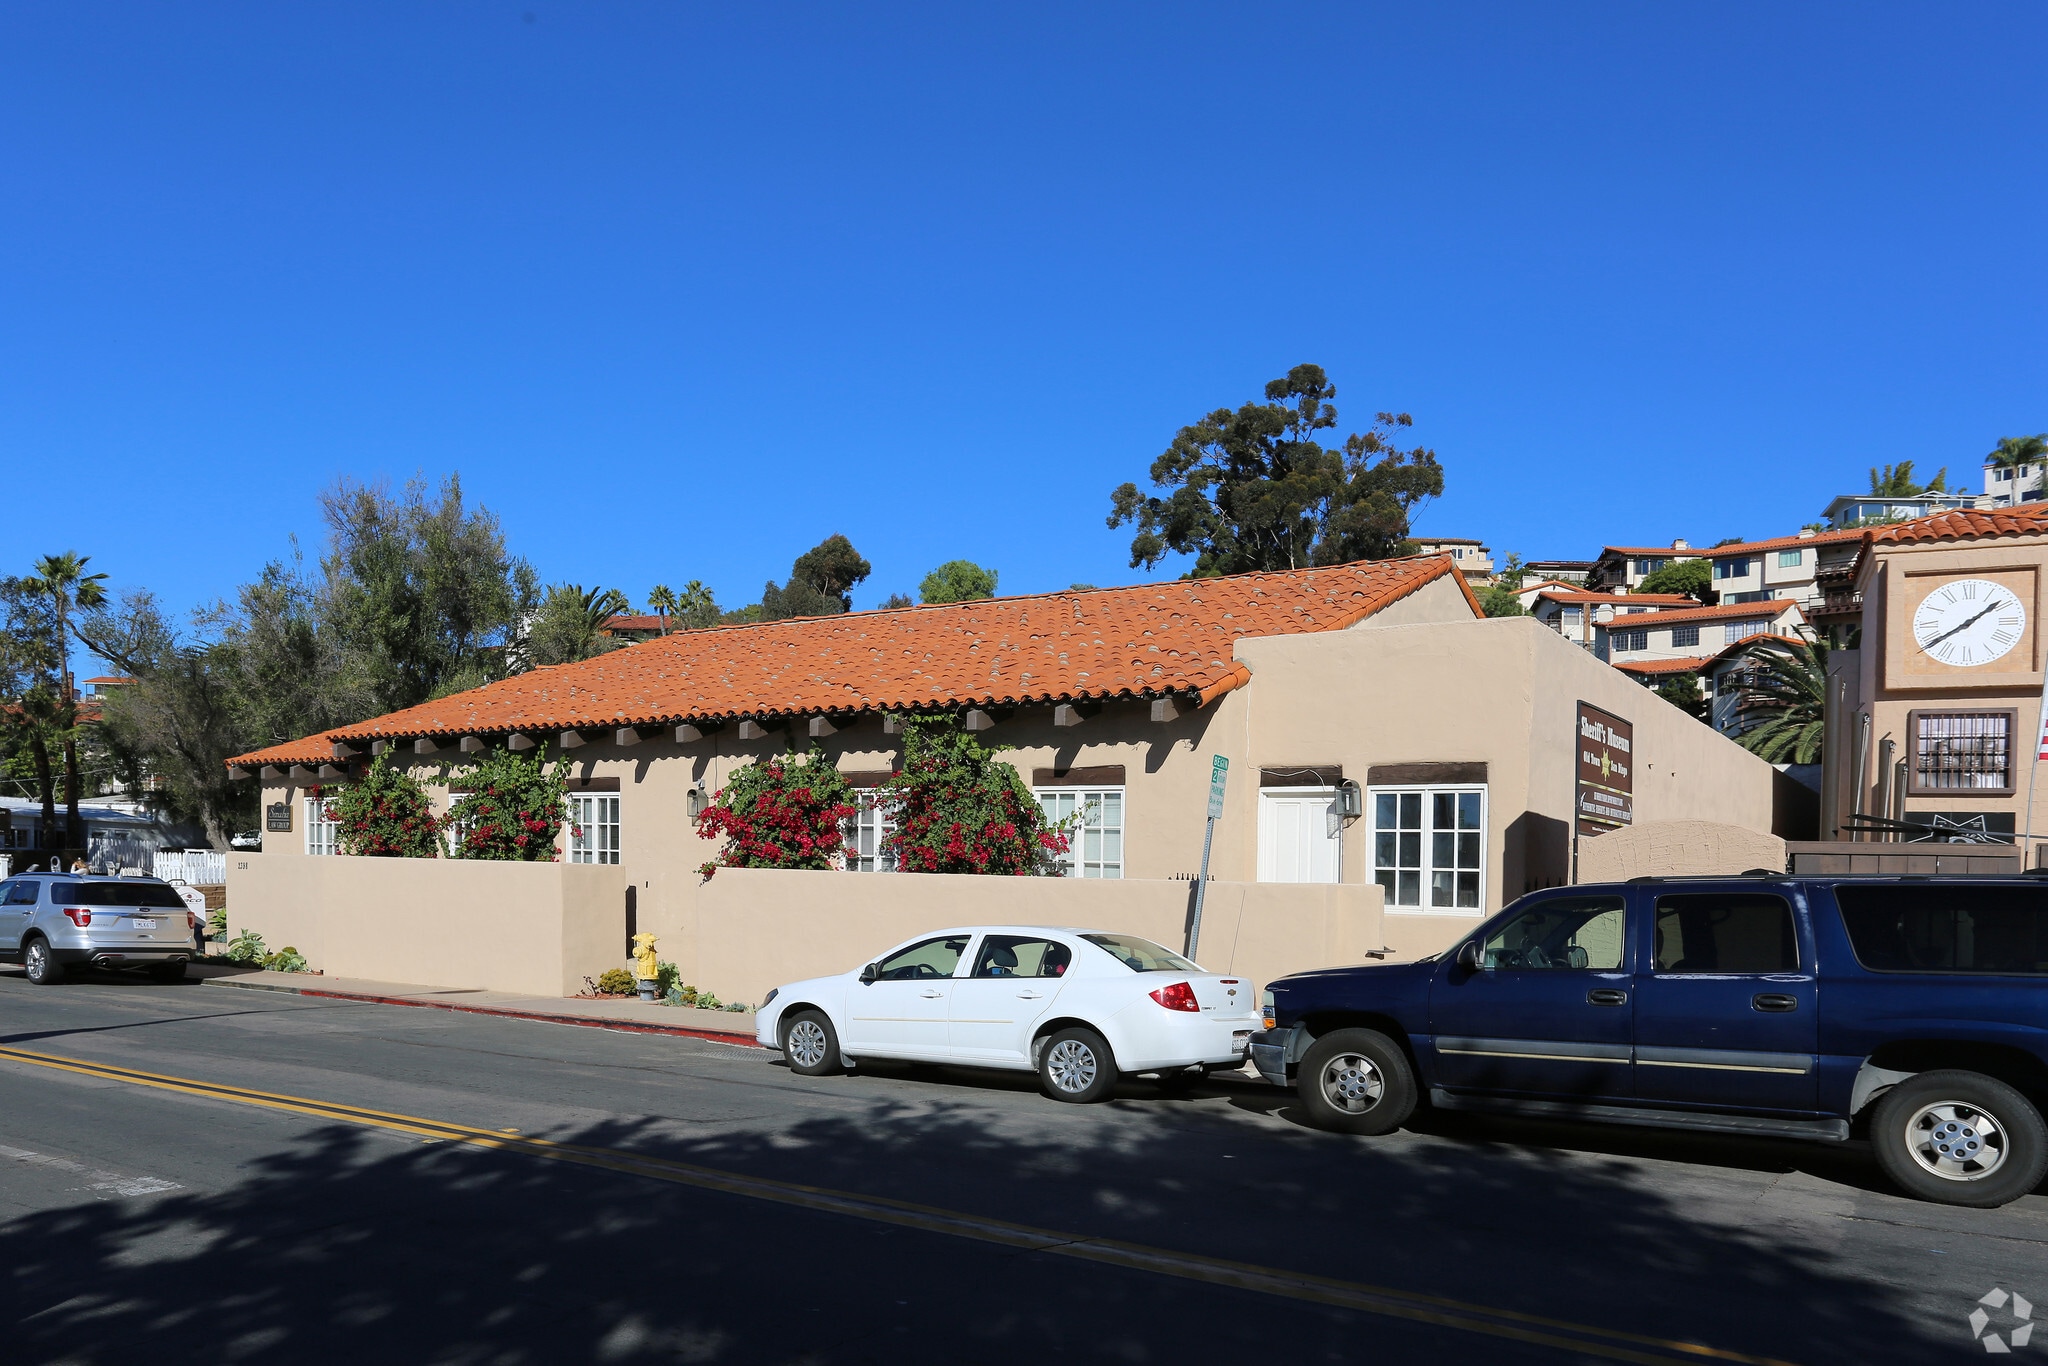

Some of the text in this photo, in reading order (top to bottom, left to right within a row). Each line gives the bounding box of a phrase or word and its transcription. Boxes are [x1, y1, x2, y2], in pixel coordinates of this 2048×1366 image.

[1581, 716, 1630, 753] Sheriff's Museum
[1213, 771, 1218, 781] 2
[1591, 752, 1600, 767] Town
[1618, 762, 1628, 778] Diego
